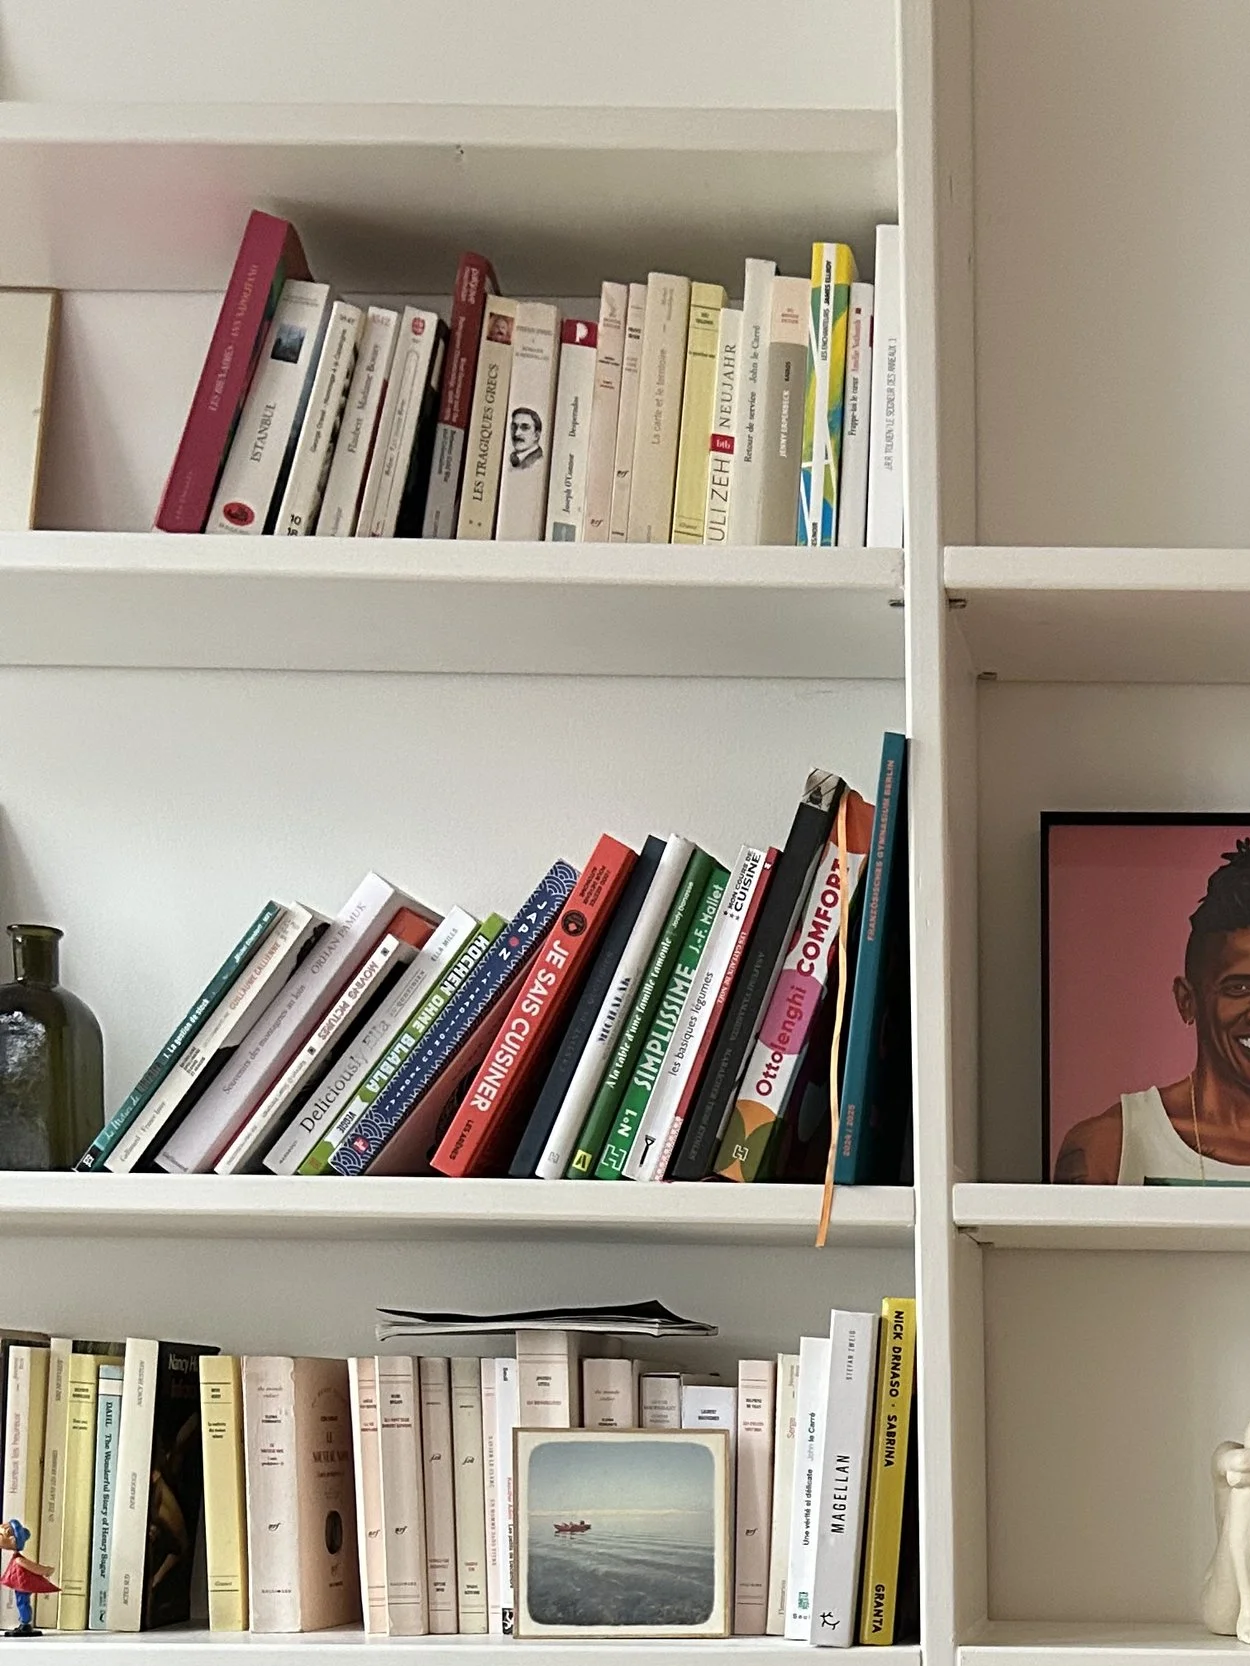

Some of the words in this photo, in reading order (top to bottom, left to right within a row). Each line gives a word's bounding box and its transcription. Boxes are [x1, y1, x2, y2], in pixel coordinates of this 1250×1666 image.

[750, 324, 760, 349] Carré
[750, 350, 759, 359] le
[483, 362, 499, 403] GRECS
[718, 343, 736, 429] NEUJAHR
[748, 361, 759, 383] John
[746, 391, 756, 419] service
[247, 400, 278, 463] ISTANBUL
[475, 405, 495, 476] TRAGIQUES
[744, 434, 754, 462] Retour
[746, 421, 754, 433] de
[472, 479, 485, 501] LES
[733, 852, 761, 913] CUISINE
[437, 932, 493, 997] KOCHEN
[543, 938, 571, 969] JE
[346, 959, 379, 1001] MOVING
[518, 966, 557, 1018] SAIS
[631, 962, 697, 1090] SIMPLISSIME
[687, 924, 709, 954] J.-F.
[698, 882, 725, 925] Mallet
[689, 970, 717, 1015] légumes
[316, 999, 351, 1042] PICTURES
[409, 992, 446, 1034] OHNE
[674, 1015, 700, 1060] basiques
[753, 982, 808, 1099] Ottolenghi
[298, 1048, 371, 1136] Deliciously
[360, 1016, 391, 1050] Ella
[363, 1031, 417, 1095] BLABLA
[470, 1013, 532, 1115] CUISINER
[667, 1059, 682, 1076] les
[335, 1109, 357, 1134] VEGGIE
[892, 1310, 904, 1340] NICK
[888, 1345, 901, 1397] DRNASO
[104, 1400, 114, 1427] DAHL
[103, 1434, 112, 1450] The
[883, 1414, 896, 1467] SABRINA
[101, 1450, 111, 1492] Wonderful
[99, 1493, 110, 1515] Story
[828, 1454, 852, 1534] MAGELLAN
[97, 1527, 108, 1553] Henry
[100, 1517, 109, 1526] of
[96, 1554, 107, 1578] Sugar
[870, 1583, 886, 1633] GRANTA
